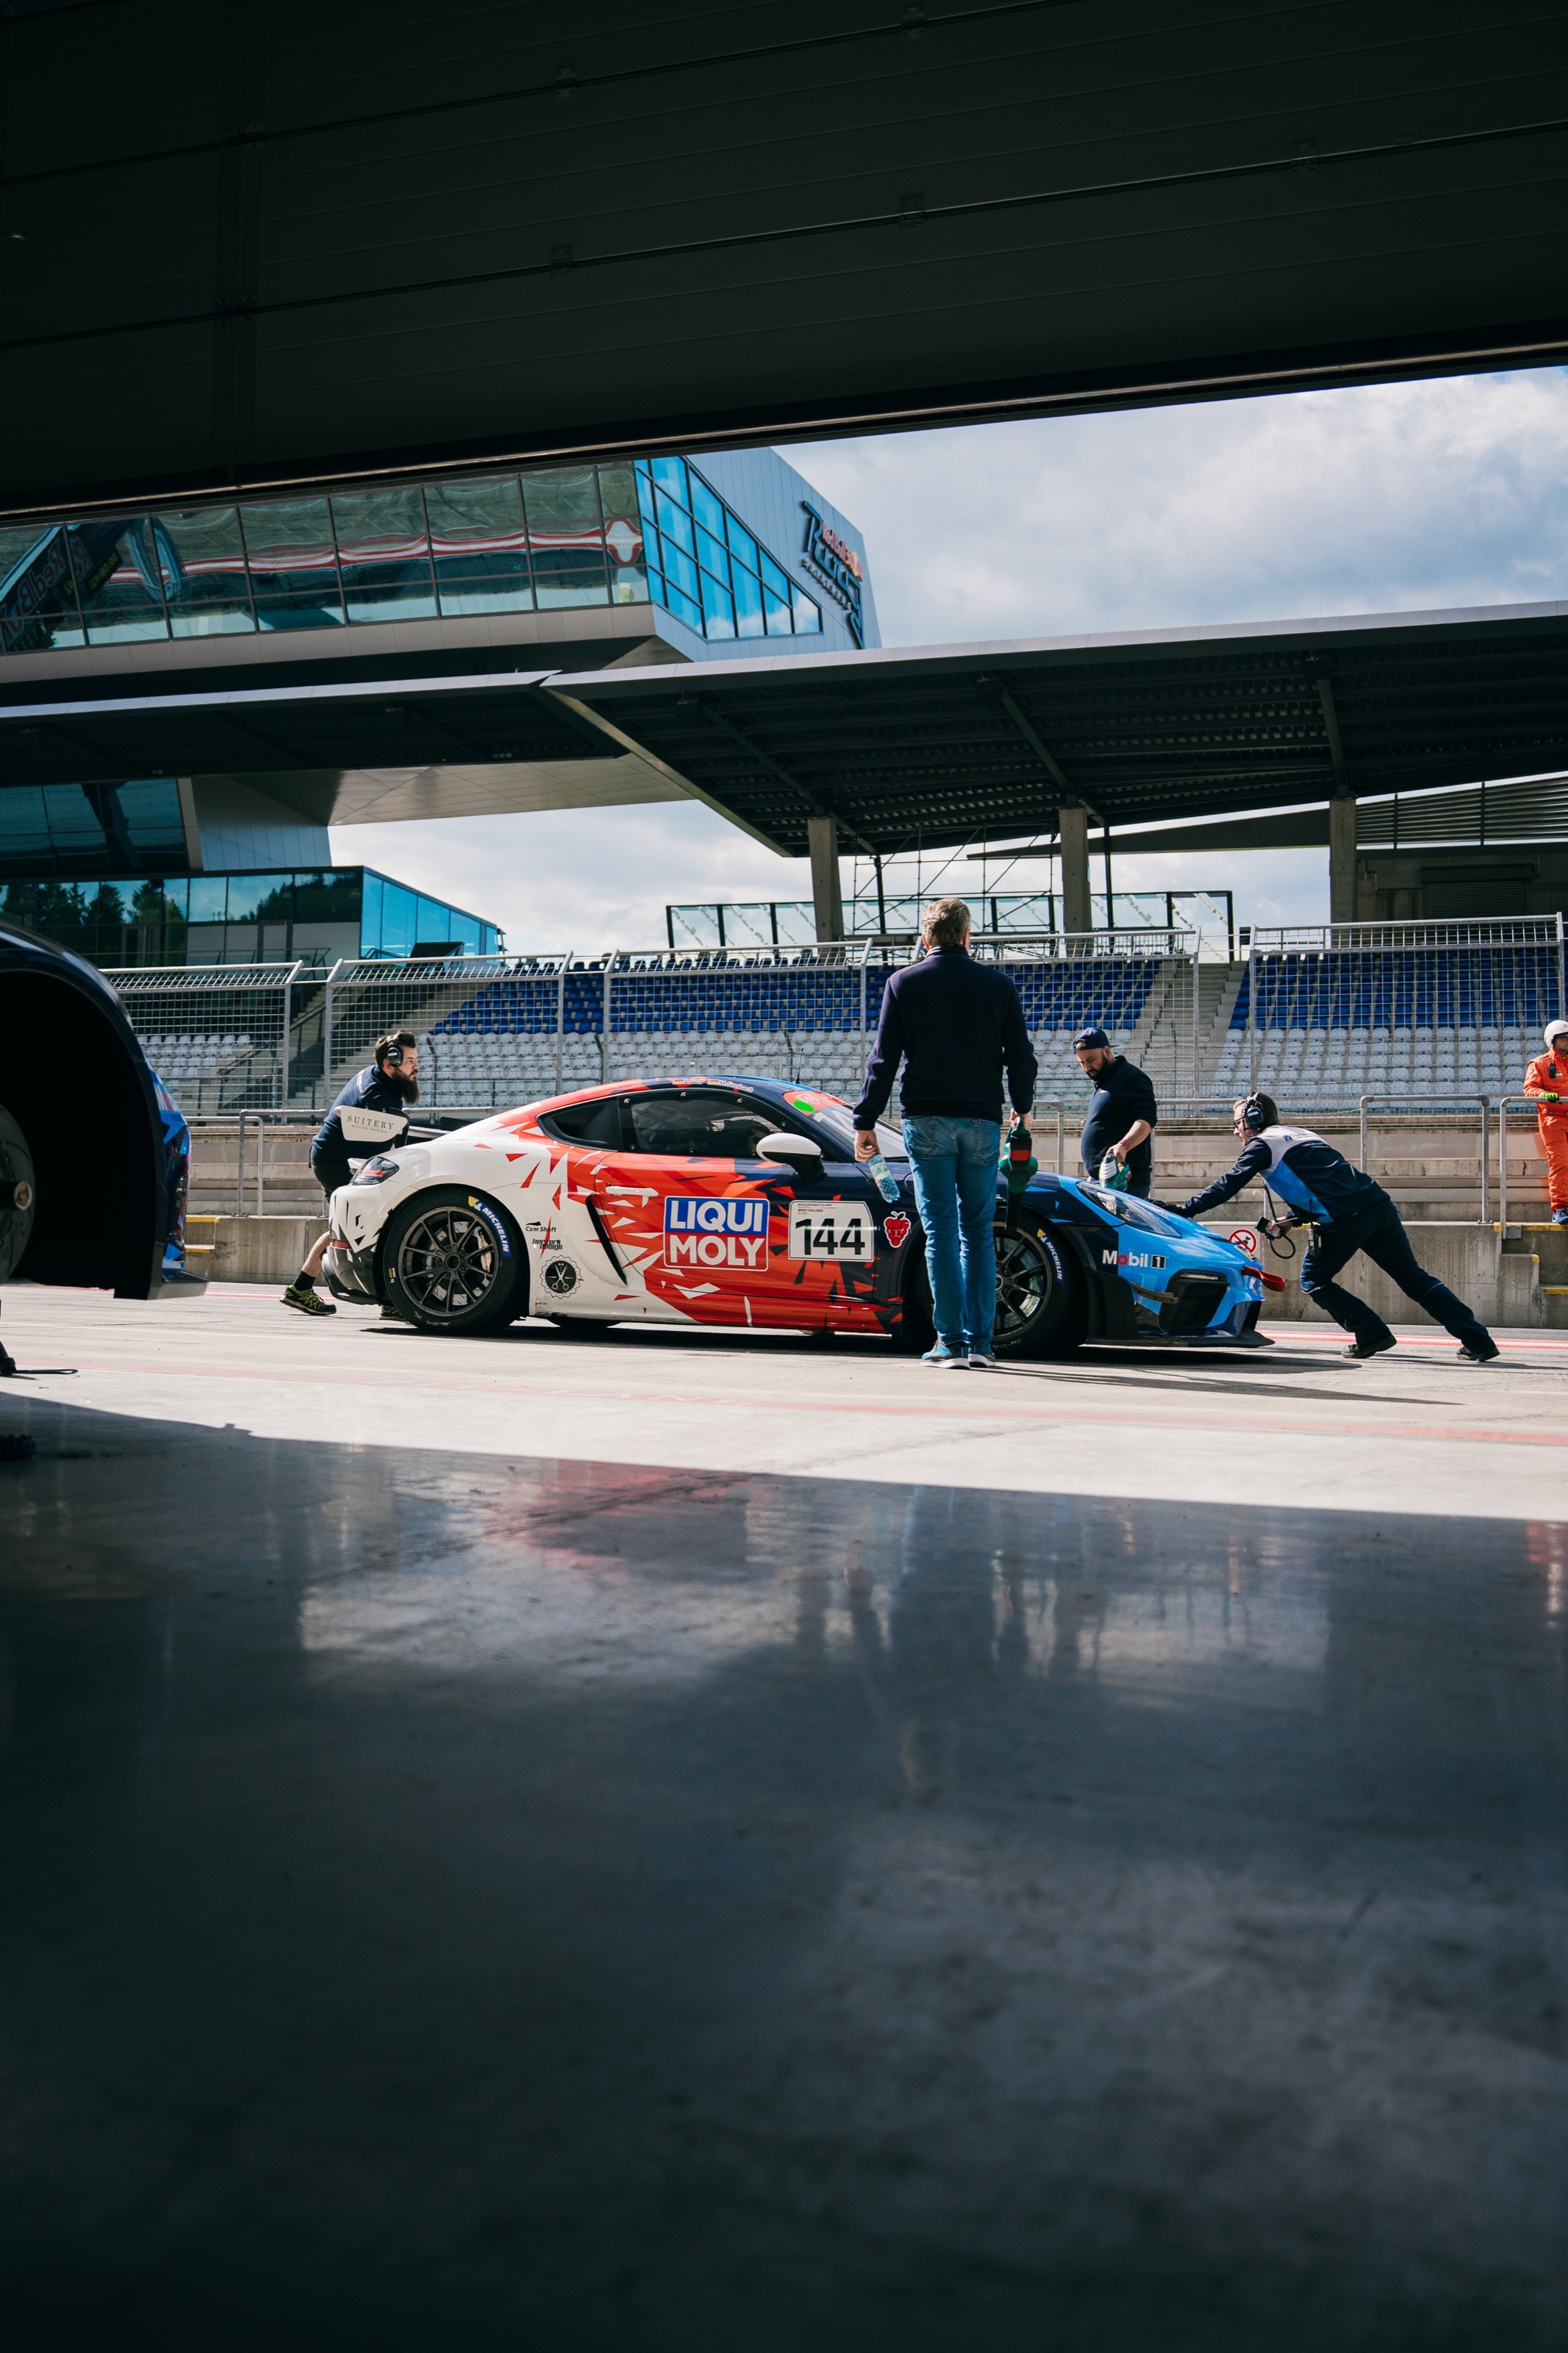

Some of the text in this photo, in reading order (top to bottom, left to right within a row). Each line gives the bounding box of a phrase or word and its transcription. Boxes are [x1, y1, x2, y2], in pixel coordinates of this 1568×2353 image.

[347, 1115, 394, 1129] SUITERY
[482, 1207, 509, 1252] MICHELIN
[670, 1200, 764, 1233] LIQUI
[670, 1235, 765, 1266] MOLY
[795, 1218, 865, 1255] 144
[1045, 1241, 1063, 1280] MICHELIN
[1103, 1249, 1148, 1268] Mobil
